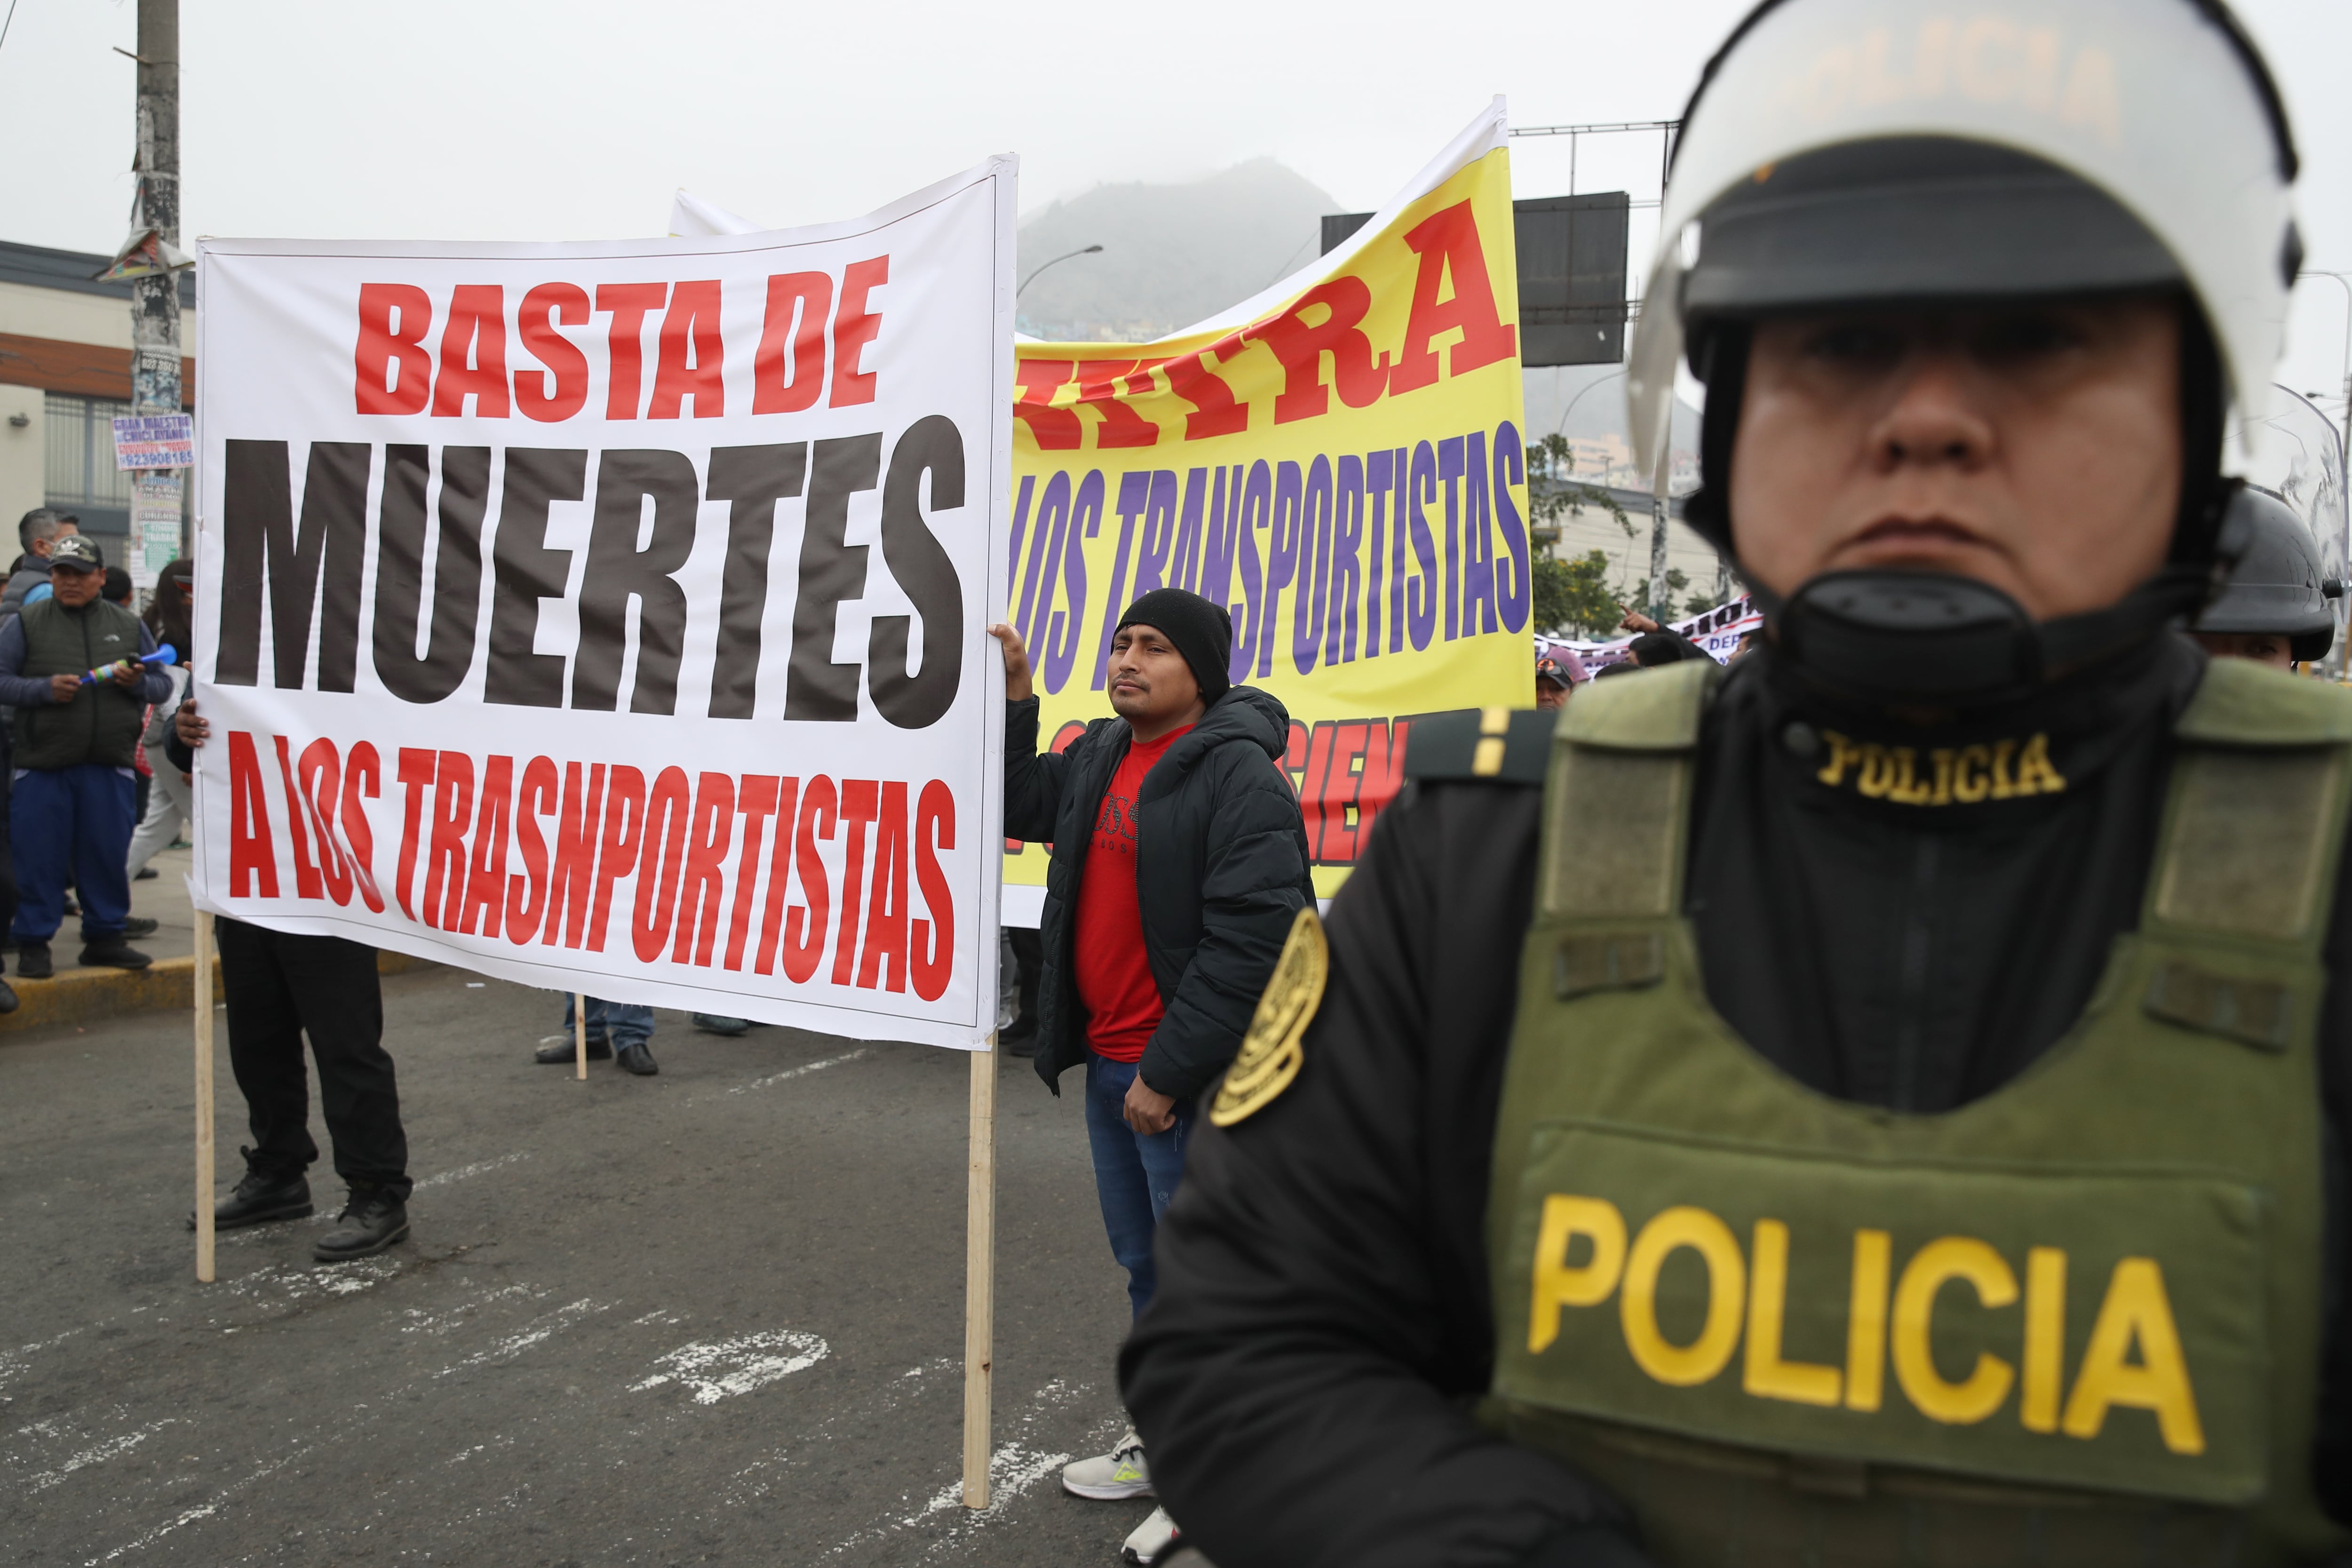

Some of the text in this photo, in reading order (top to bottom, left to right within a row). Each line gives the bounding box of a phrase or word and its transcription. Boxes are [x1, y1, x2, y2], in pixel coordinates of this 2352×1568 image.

[114, 416, 191, 430] GRAN MAESTRO
[123, 429, 185, 442] CHICLAYANO
[356, 255, 889, 423] BASTA DE
[214, 414, 966, 730] MUERTES
[1090, 420, 1530, 691] TRANSPORTISTAS
[229, 731, 279, 898] A
[275, 735, 385, 914] LOS
[397, 747, 955, 1002] TRASNPORTISTAS
[1817, 729, 2067, 806] POLICIA
[1527, 1193, 2206, 1456] POLICIA
